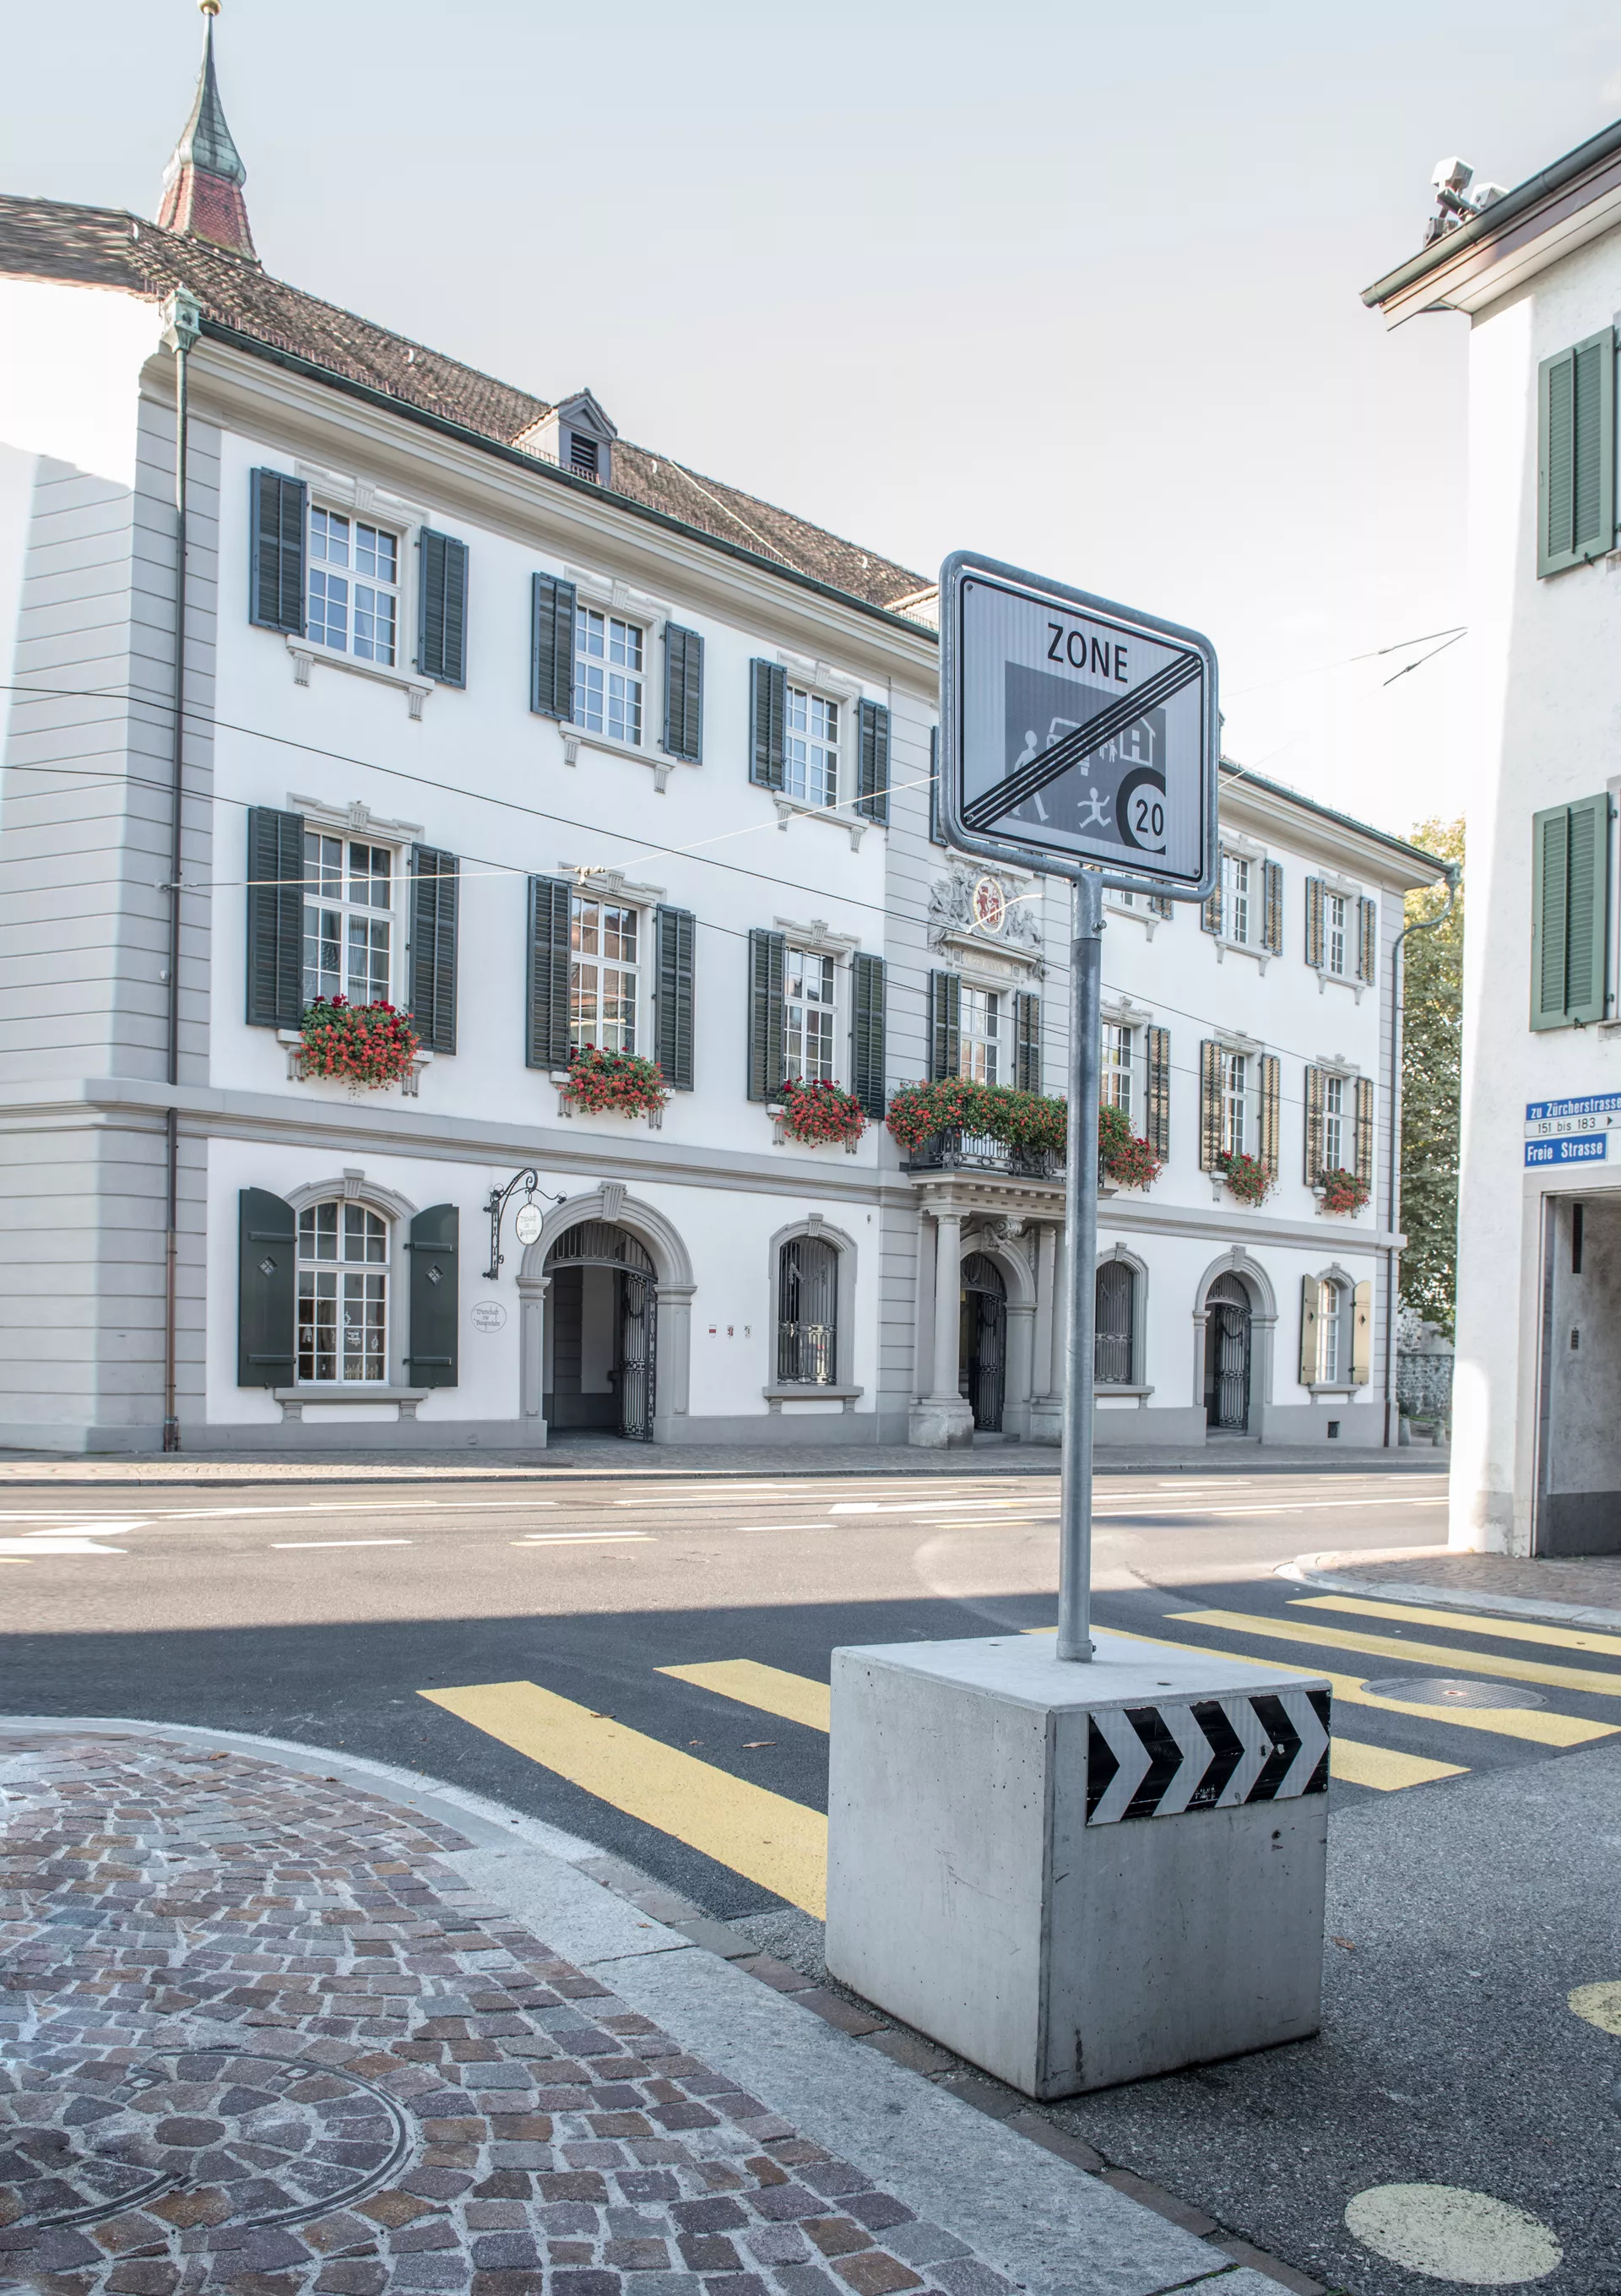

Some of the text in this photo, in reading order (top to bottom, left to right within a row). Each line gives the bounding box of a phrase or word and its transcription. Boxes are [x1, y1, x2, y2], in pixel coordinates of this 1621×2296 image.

[1047, 622, 1129, 684] ZONE
[1136, 798, 1164, 837] 20
[1531, 1097, 1621, 1119] zu Zürcherstrasse
[1537, 1117, 1596, 1133] 151 bis 183
[1526, 1142, 1603, 1161] Freie Strasse
